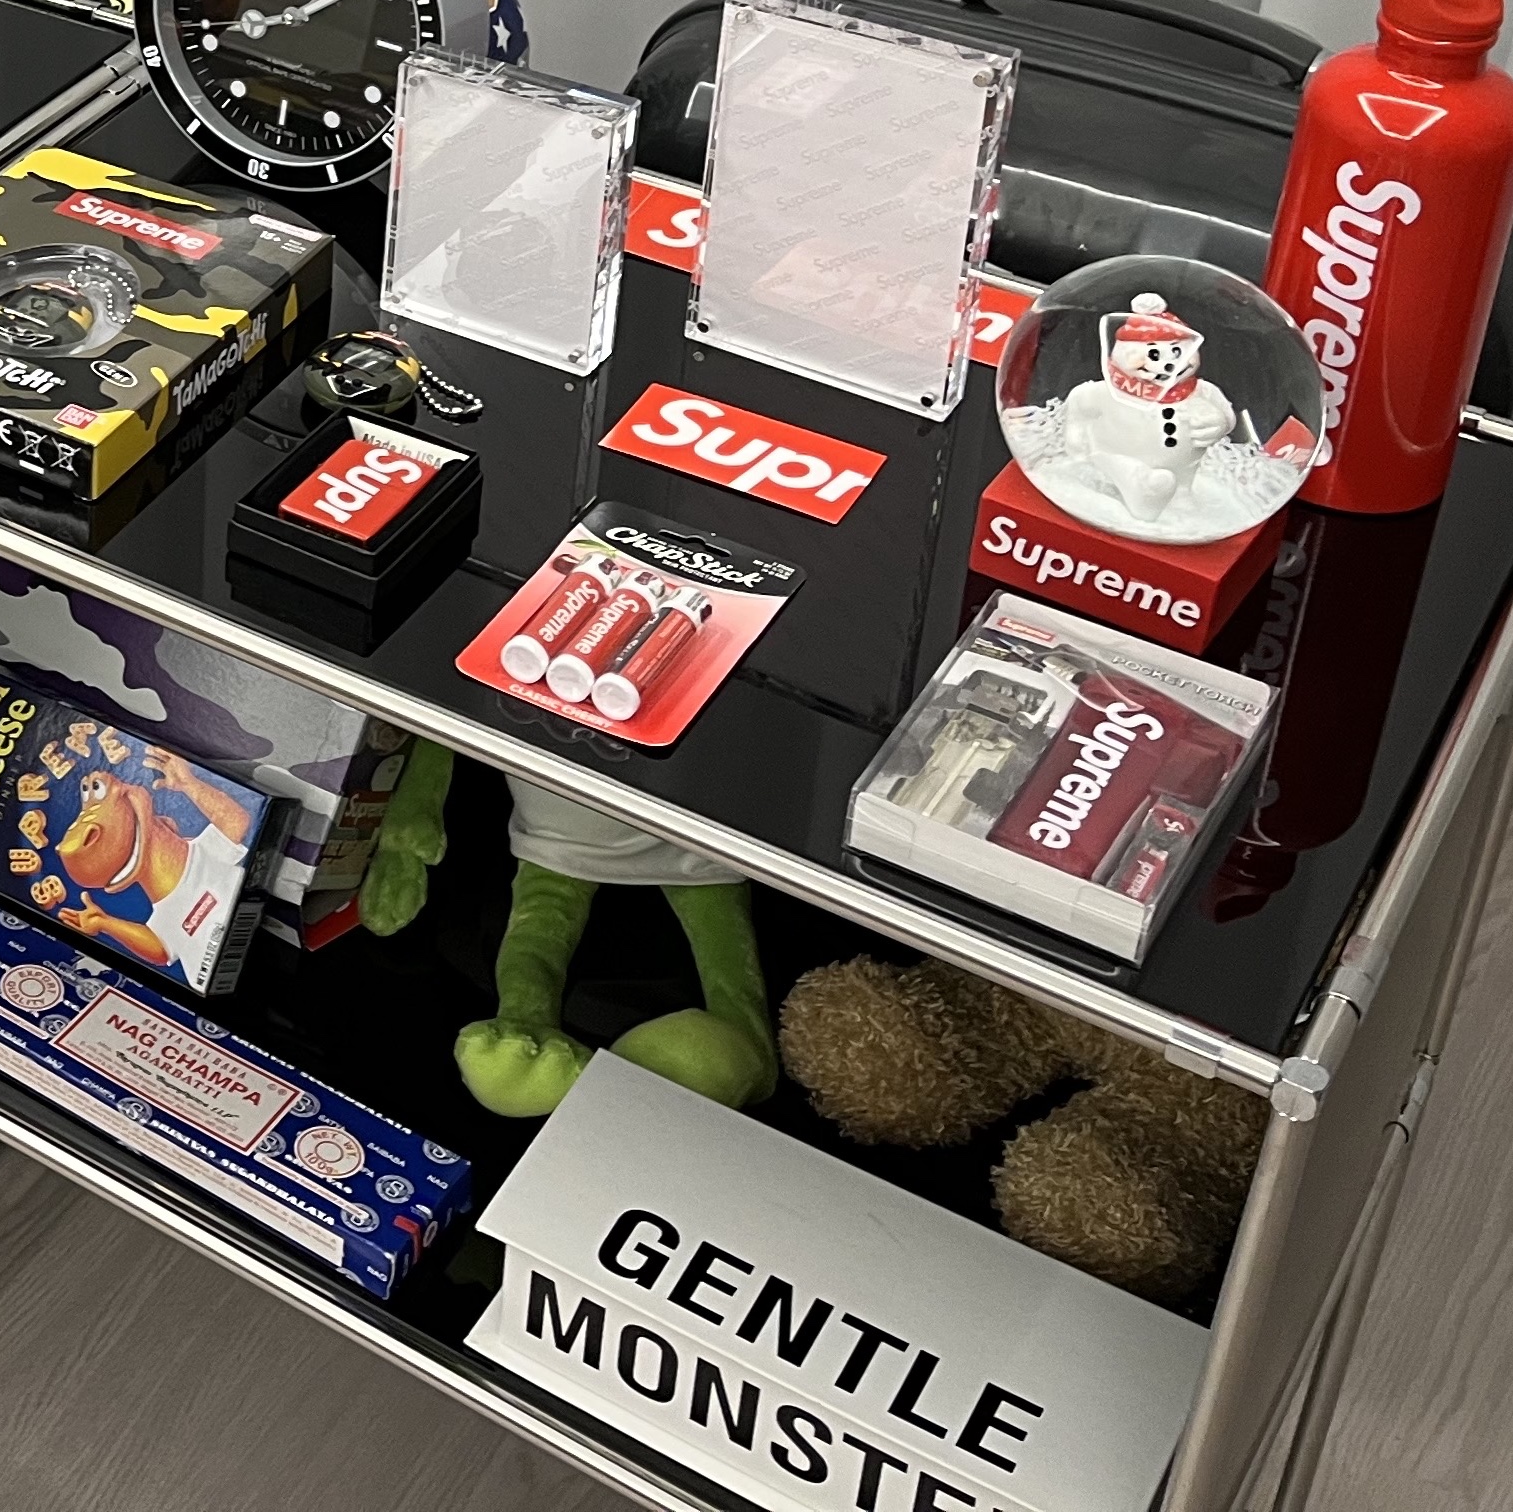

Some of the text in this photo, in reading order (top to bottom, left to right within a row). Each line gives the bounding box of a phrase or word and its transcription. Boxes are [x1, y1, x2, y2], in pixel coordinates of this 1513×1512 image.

[142, 44, 162, 68] 40
[763, 70, 830, 102] Supreme
[825, 85, 893, 118] Supreme
[888, 100, 959, 133] Supreme
[247, 158, 271, 181] 30
[541, 151, 604, 182] Supreme
[69, 196, 206, 251] Supreme
[839, 196, 906, 228] Supreme
[812, 244, 880, 274] Supreme
[362, 433, 443, 470] Made in USA
[631, 398, 873, 503] Supr
[313, 448, 423, 524] Supr
[605, 526, 765, 588] ChapStick
[981, 514, 1202, 629] Supreme
[538, 580, 600, 643] Supreme
[574, 593, 640, 655] Supreme
[508, 682, 614, 729] CLASSIC CHERRY
[1112, 653, 1262, 717] POCKET TORCH
[1029, 701, 1165, 850] Supreme
[8, 722, 132, 910] SUPREME
[6, 980, 47, 1006] QUALITY
[18, 969, 58, 995] EXPORT
[105, 1013, 159, 1050] NAG
[160, 1044, 263, 1107] CHAMPA
[125, 1044, 223, 1100] AGARBATTI
[141, 1018, 184, 1045] SATYA
[186, 1041, 212, 1061] SAI
[211, 1057, 248, 1080] BABA
[597, 1208, 1045, 1474] GENTLE
[525, 1269, 1000, 1512] MONSTE
